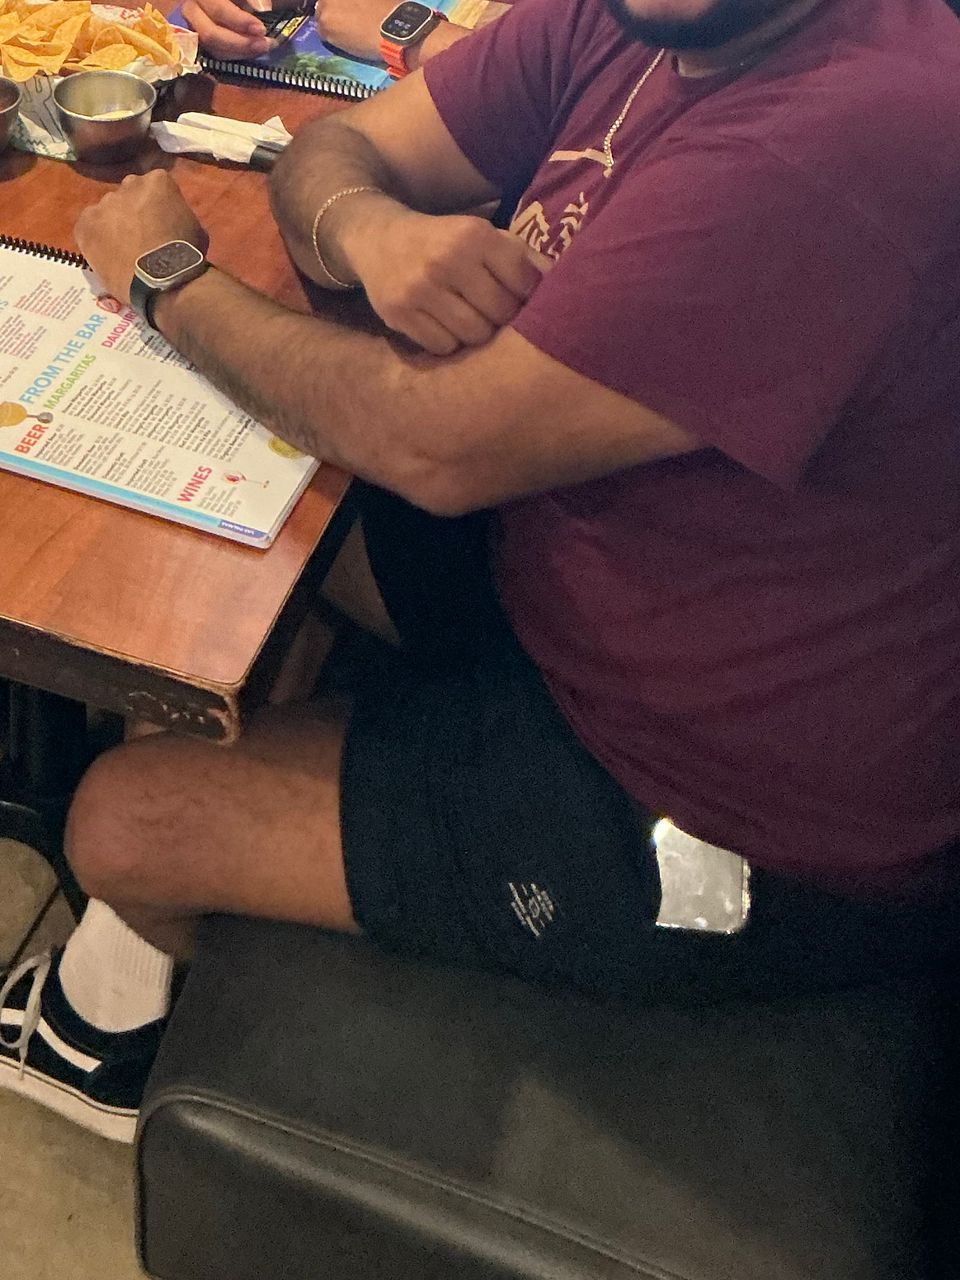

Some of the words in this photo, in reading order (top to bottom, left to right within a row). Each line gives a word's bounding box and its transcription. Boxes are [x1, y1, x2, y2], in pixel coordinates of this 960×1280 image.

[19, 365, 64, 404] FROM
[53, 339, 85, 363] THE
[76, 314, 106, 340] BAR
[43, 353, 97, 410] MARGARITAS
[14, 424, 49, 455] BEER
[177, 465, 213, 503] WINES
